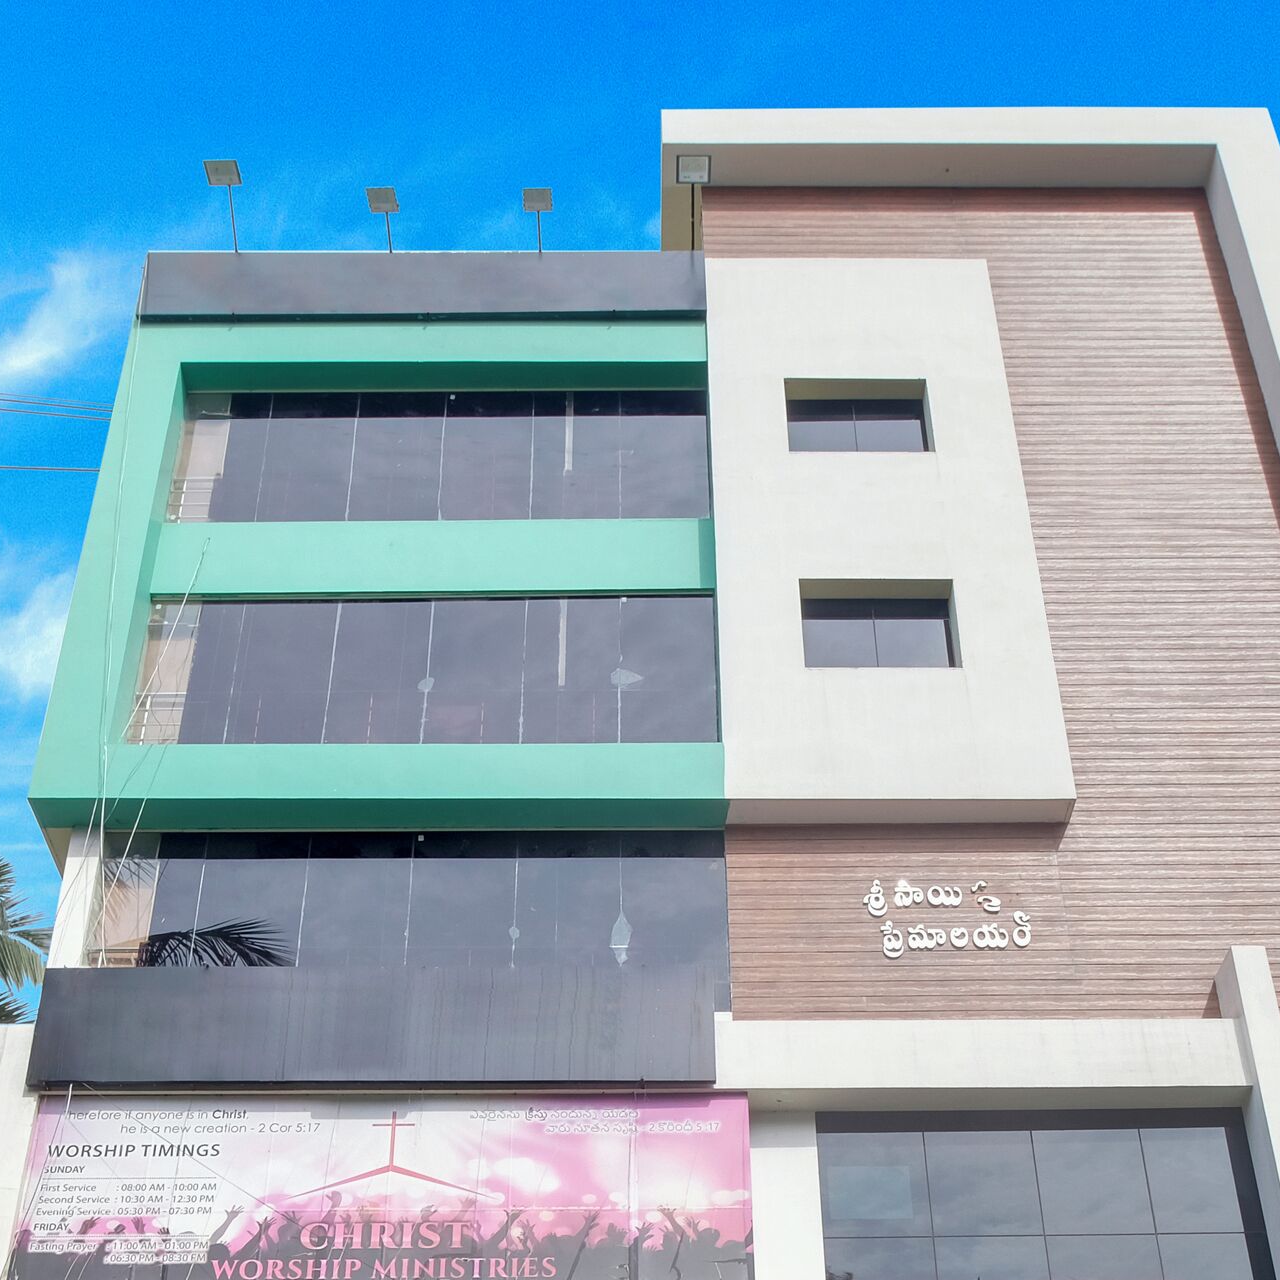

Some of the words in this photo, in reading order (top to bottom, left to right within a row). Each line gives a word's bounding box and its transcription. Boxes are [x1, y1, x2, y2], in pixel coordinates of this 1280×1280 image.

[135, 1111, 183, 1122] anyone
[186, 1110, 194, 1120] is
[197, 1110, 208, 1120] in
[120, 1123, 137, 1134] he
[140, 1123, 148, 1134] is
[151, 1125, 160, 1134] a
[164, 1125, 191, 1134] new
[194, 1123, 247, 1134] creation
[258, 1123, 267, 1133] 2
[270, 1123, 292, 1133] Cor
[295, 1122, 320, 1133] 5:17
[48, 1144, 136, 1158] WORSHIP
[141, 1143, 221, 1157] TIMINGS
[44, 1165, 85, 1175] SUNDAY
[40, 1183, 60, 1192] First
[62, 1183, 97, 1192] Service
[121, 1183, 147, 1192] 08:00
[149, 1183, 165, 1192] AM
[173, 1183, 199, 1192] 10:00
[201, 1183, 217, 1191] AM
[38, 1195, 73, 1204] Second
[76, 1195, 110, 1204] Service
[120, 1195, 144, 1204] 10:30
[147, 1195, 163, 1204] AM
[172, 1195, 200, 1203] 12:30
[202, 1195, 215, 1203] PM
[36, 1207, 74, 1217] Evening
[76, 1207, 111, 1216] Service
[117, 1207, 143, 1216] 05:30
[146, 1207, 160, 1215] PM
[169, 1206, 196, 1215] 07:30
[198, 1206, 212, 1215] PM
[33, 1223, 70, 1231] FRIDAY
[300, 1222, 469, 1250] CHRIST
[30, 1242, 64, 1252] Fasting
[66, 1242, 97, 1252] Prayer
[140, 1242, 157, 1250] AM
[164, 1241, 190, 1250] 01:00
[193, 1241, 209, 1249] PM
[110, 1254, 136, 1262] 06:30
[138, 1254, 154, 1262] PM
[162, 1253, 188, 1262] 08:30
[211, 1258, 362, 1280] WORSHIP
[370, 1256, 557, 1279] MINISTRIES
